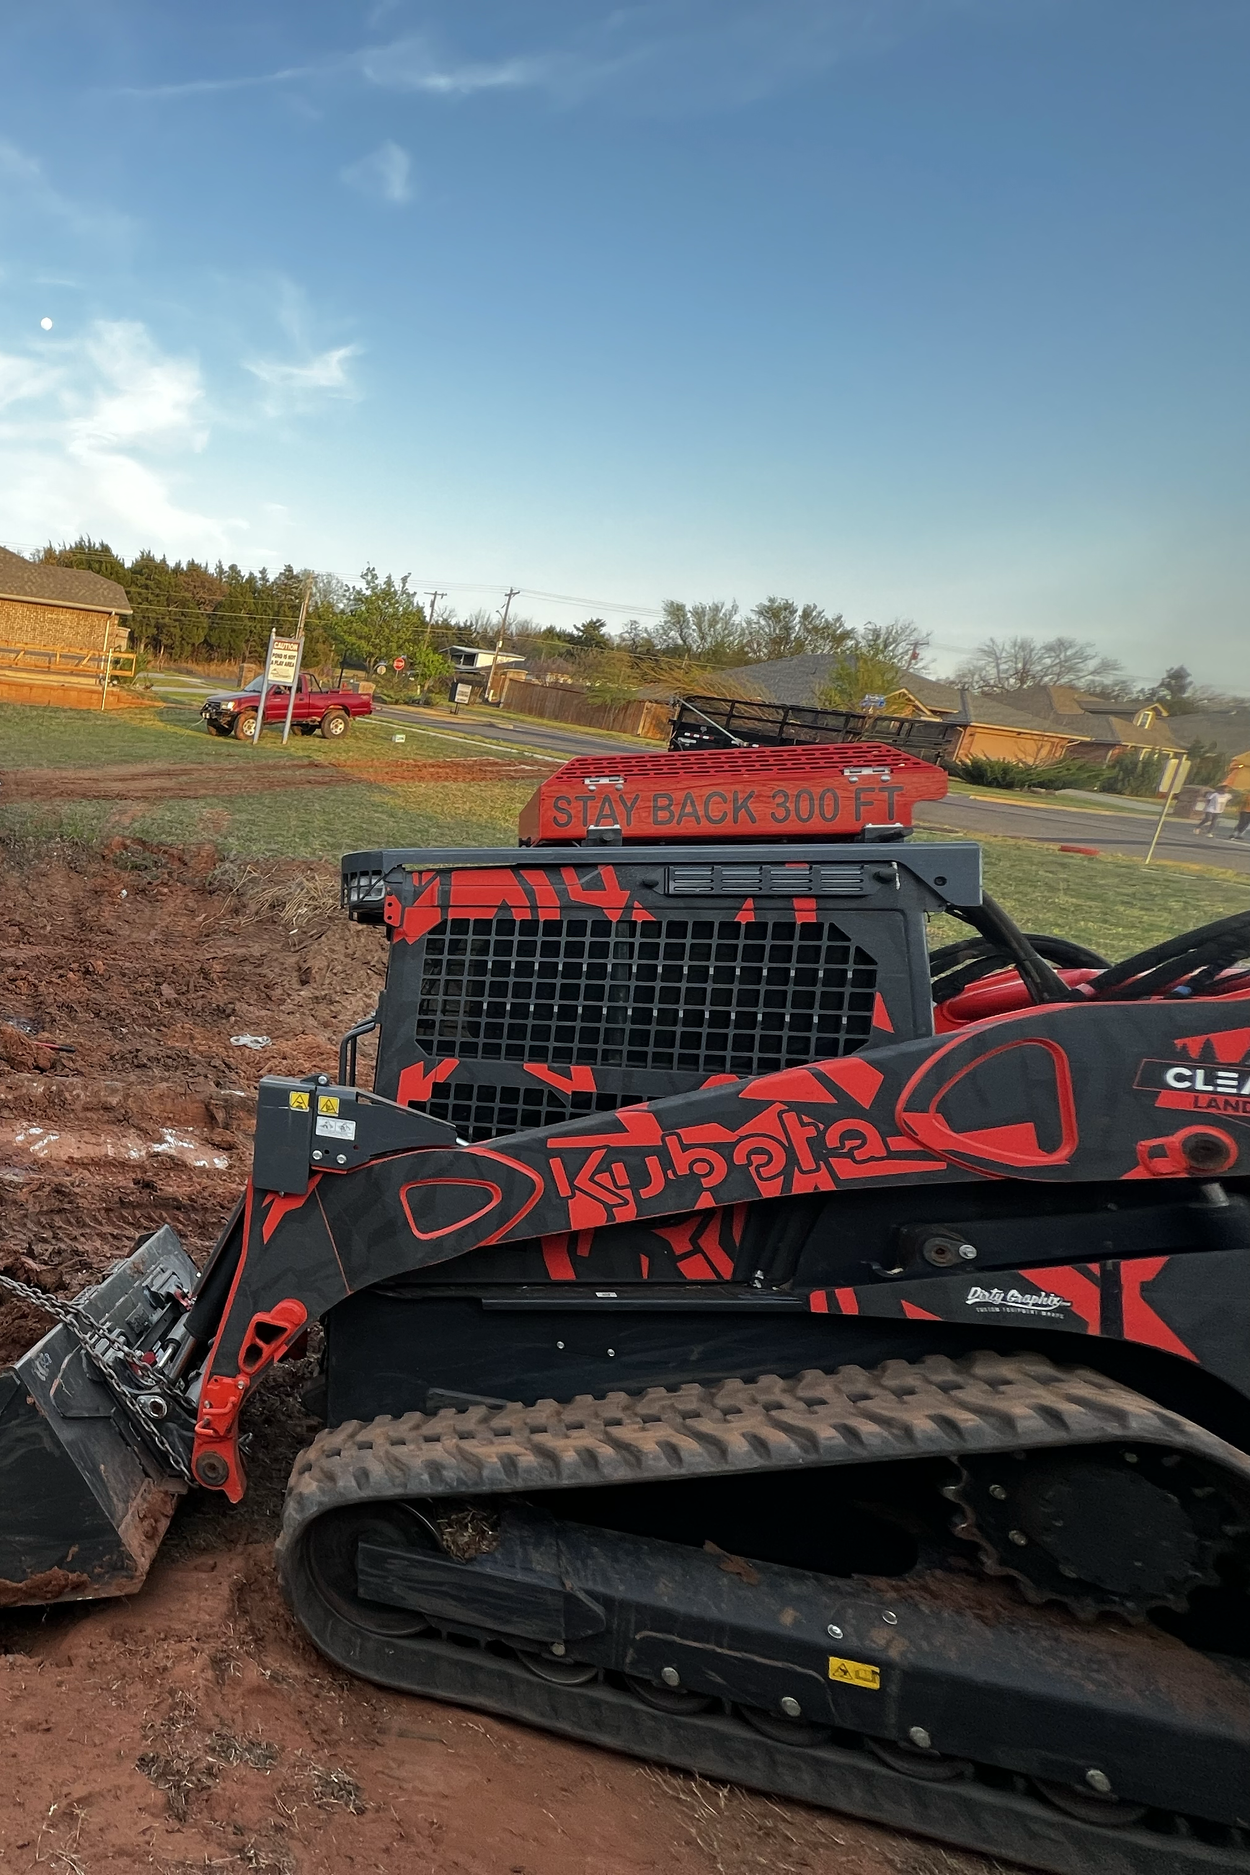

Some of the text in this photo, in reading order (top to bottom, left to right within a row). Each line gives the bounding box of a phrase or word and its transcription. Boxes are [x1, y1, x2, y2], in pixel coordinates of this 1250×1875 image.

[274, 642, 299, 651] CAUTION
[553, 786, 905, 828] STAY BACK 300 FT
[966, 1286, 1063, 1308] Dirty Graphix
